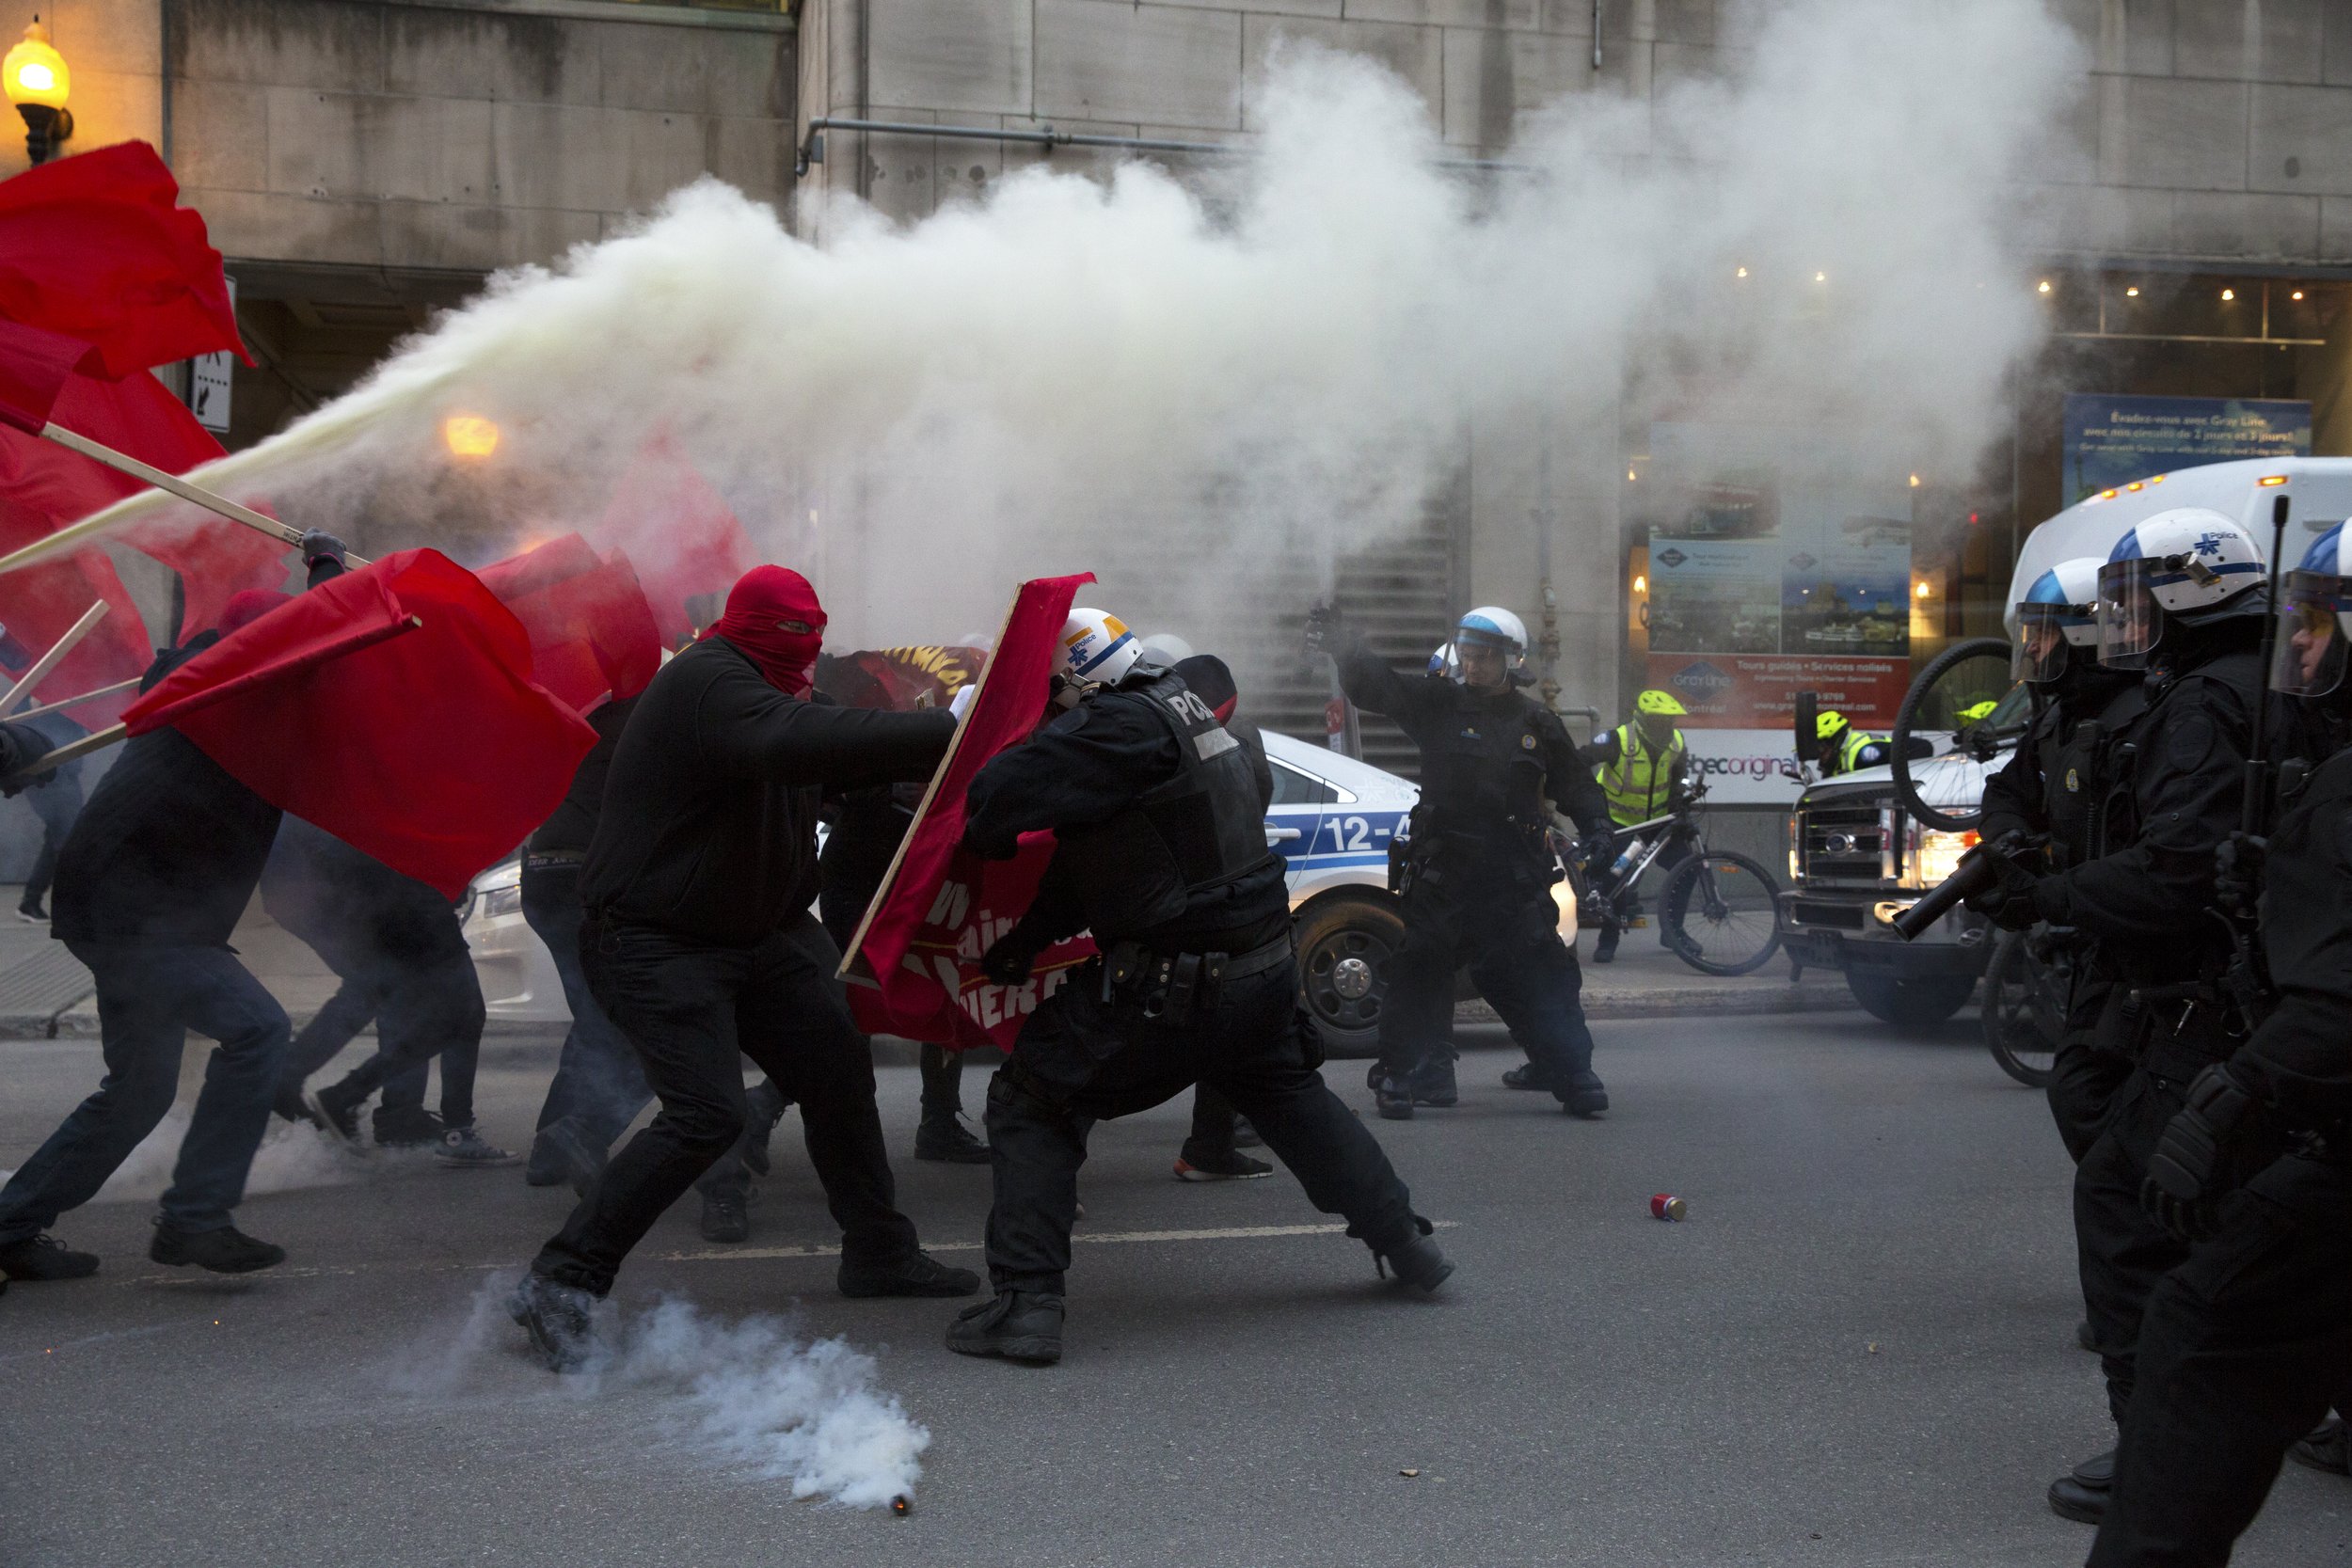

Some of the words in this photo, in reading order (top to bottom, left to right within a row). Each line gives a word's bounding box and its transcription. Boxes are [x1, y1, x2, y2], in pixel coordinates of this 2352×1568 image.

[1074, 634, 1096, 650] Police
[1737, 660, 1766, 670] Tours
[1768, 661, 1803, 673] guidés
[1811, 661, 1854, 672] Services
[1682, 702, 1726, 714] ontréal
